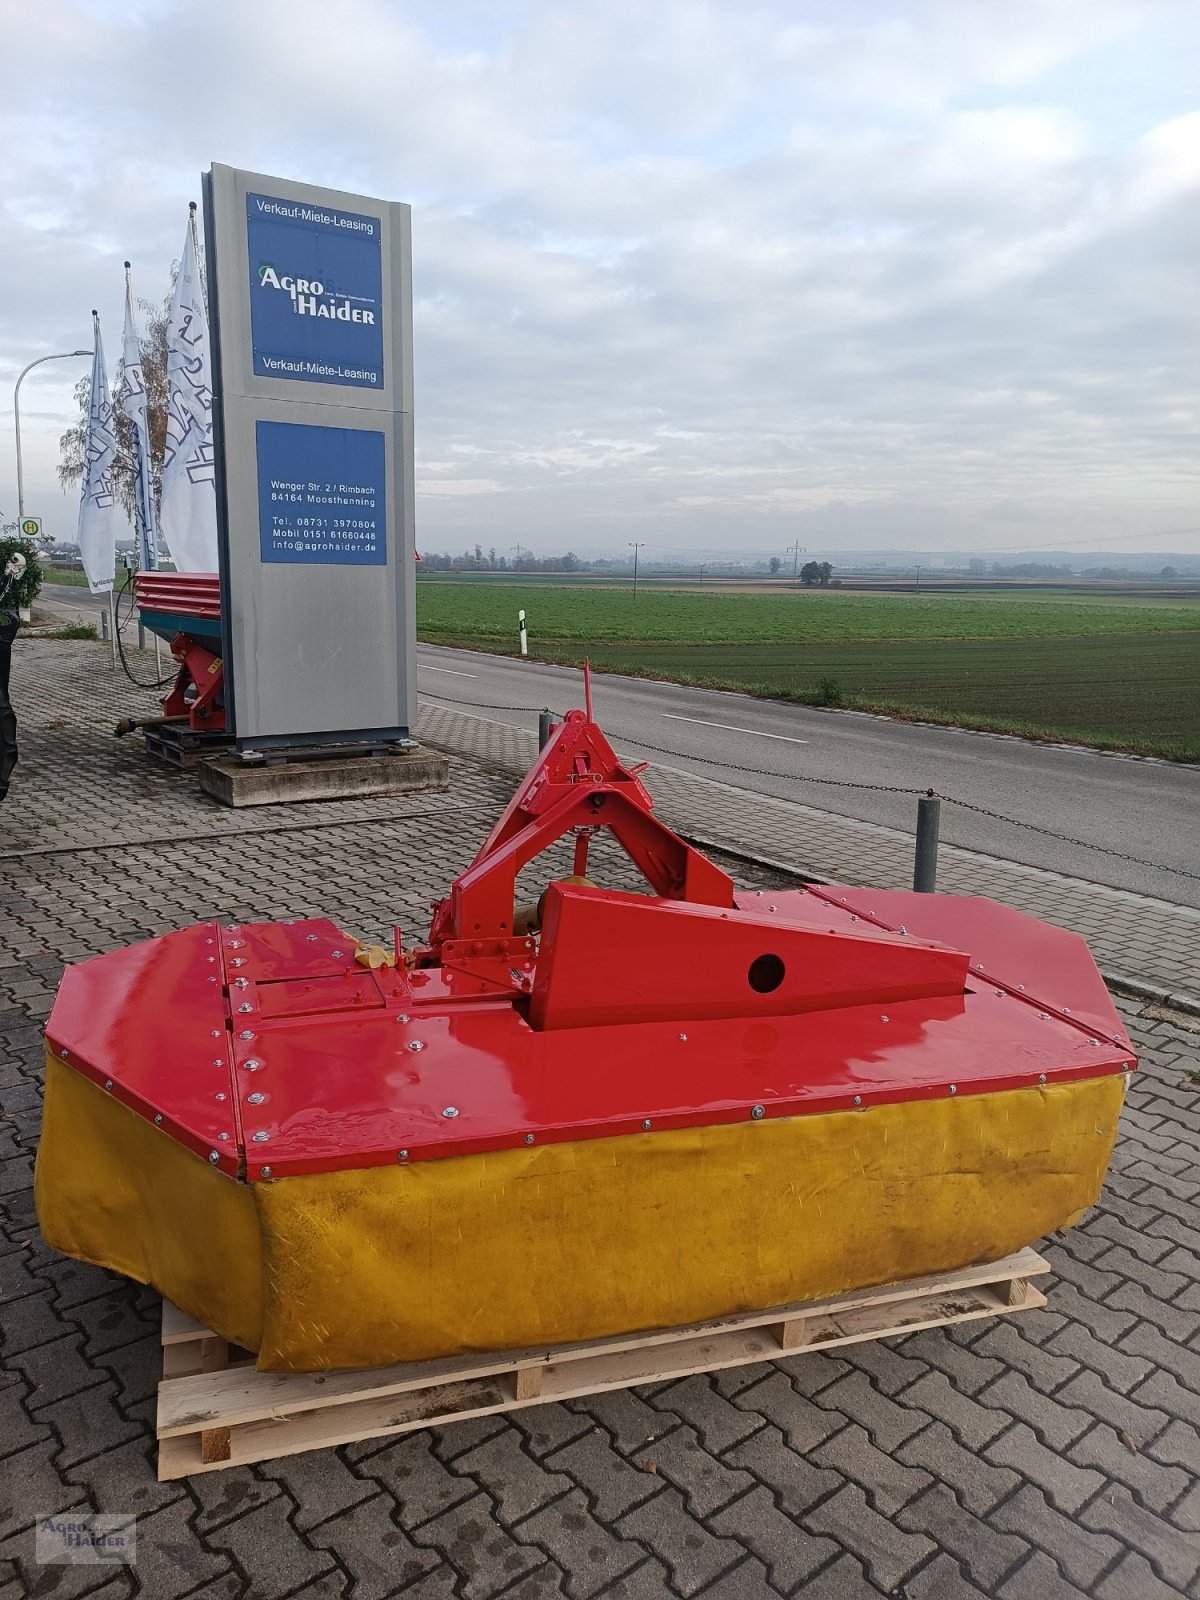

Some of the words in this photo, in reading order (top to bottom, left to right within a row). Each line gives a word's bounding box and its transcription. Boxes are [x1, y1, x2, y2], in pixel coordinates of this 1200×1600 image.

[256, 199, 373, 235] Verkauf-Miete-Leasing
[262, 357, 377, 382] Verkauf-Miete-Leasing
[271, 480, 305, 491] Wenger
[308, 482, 322, 491] Str.
[325, 483, 331, 492] 2
[339, 484, 375, 495] Rimbach
[271, 492, 302, 502] 84164
[307, 494, 375, 507] Moosthenning
[272, 516, 292, 526] Tel.
[297, 517, 328, 527] 08731
[333, 519, 376, 529] 3970804
[272, 528, 300, 538] Mobil
[303, 529, 327, 539] 0151
[330, 530, 376, 540] 61660448
[273, 540, 376, 552] info@agrohaider.de
